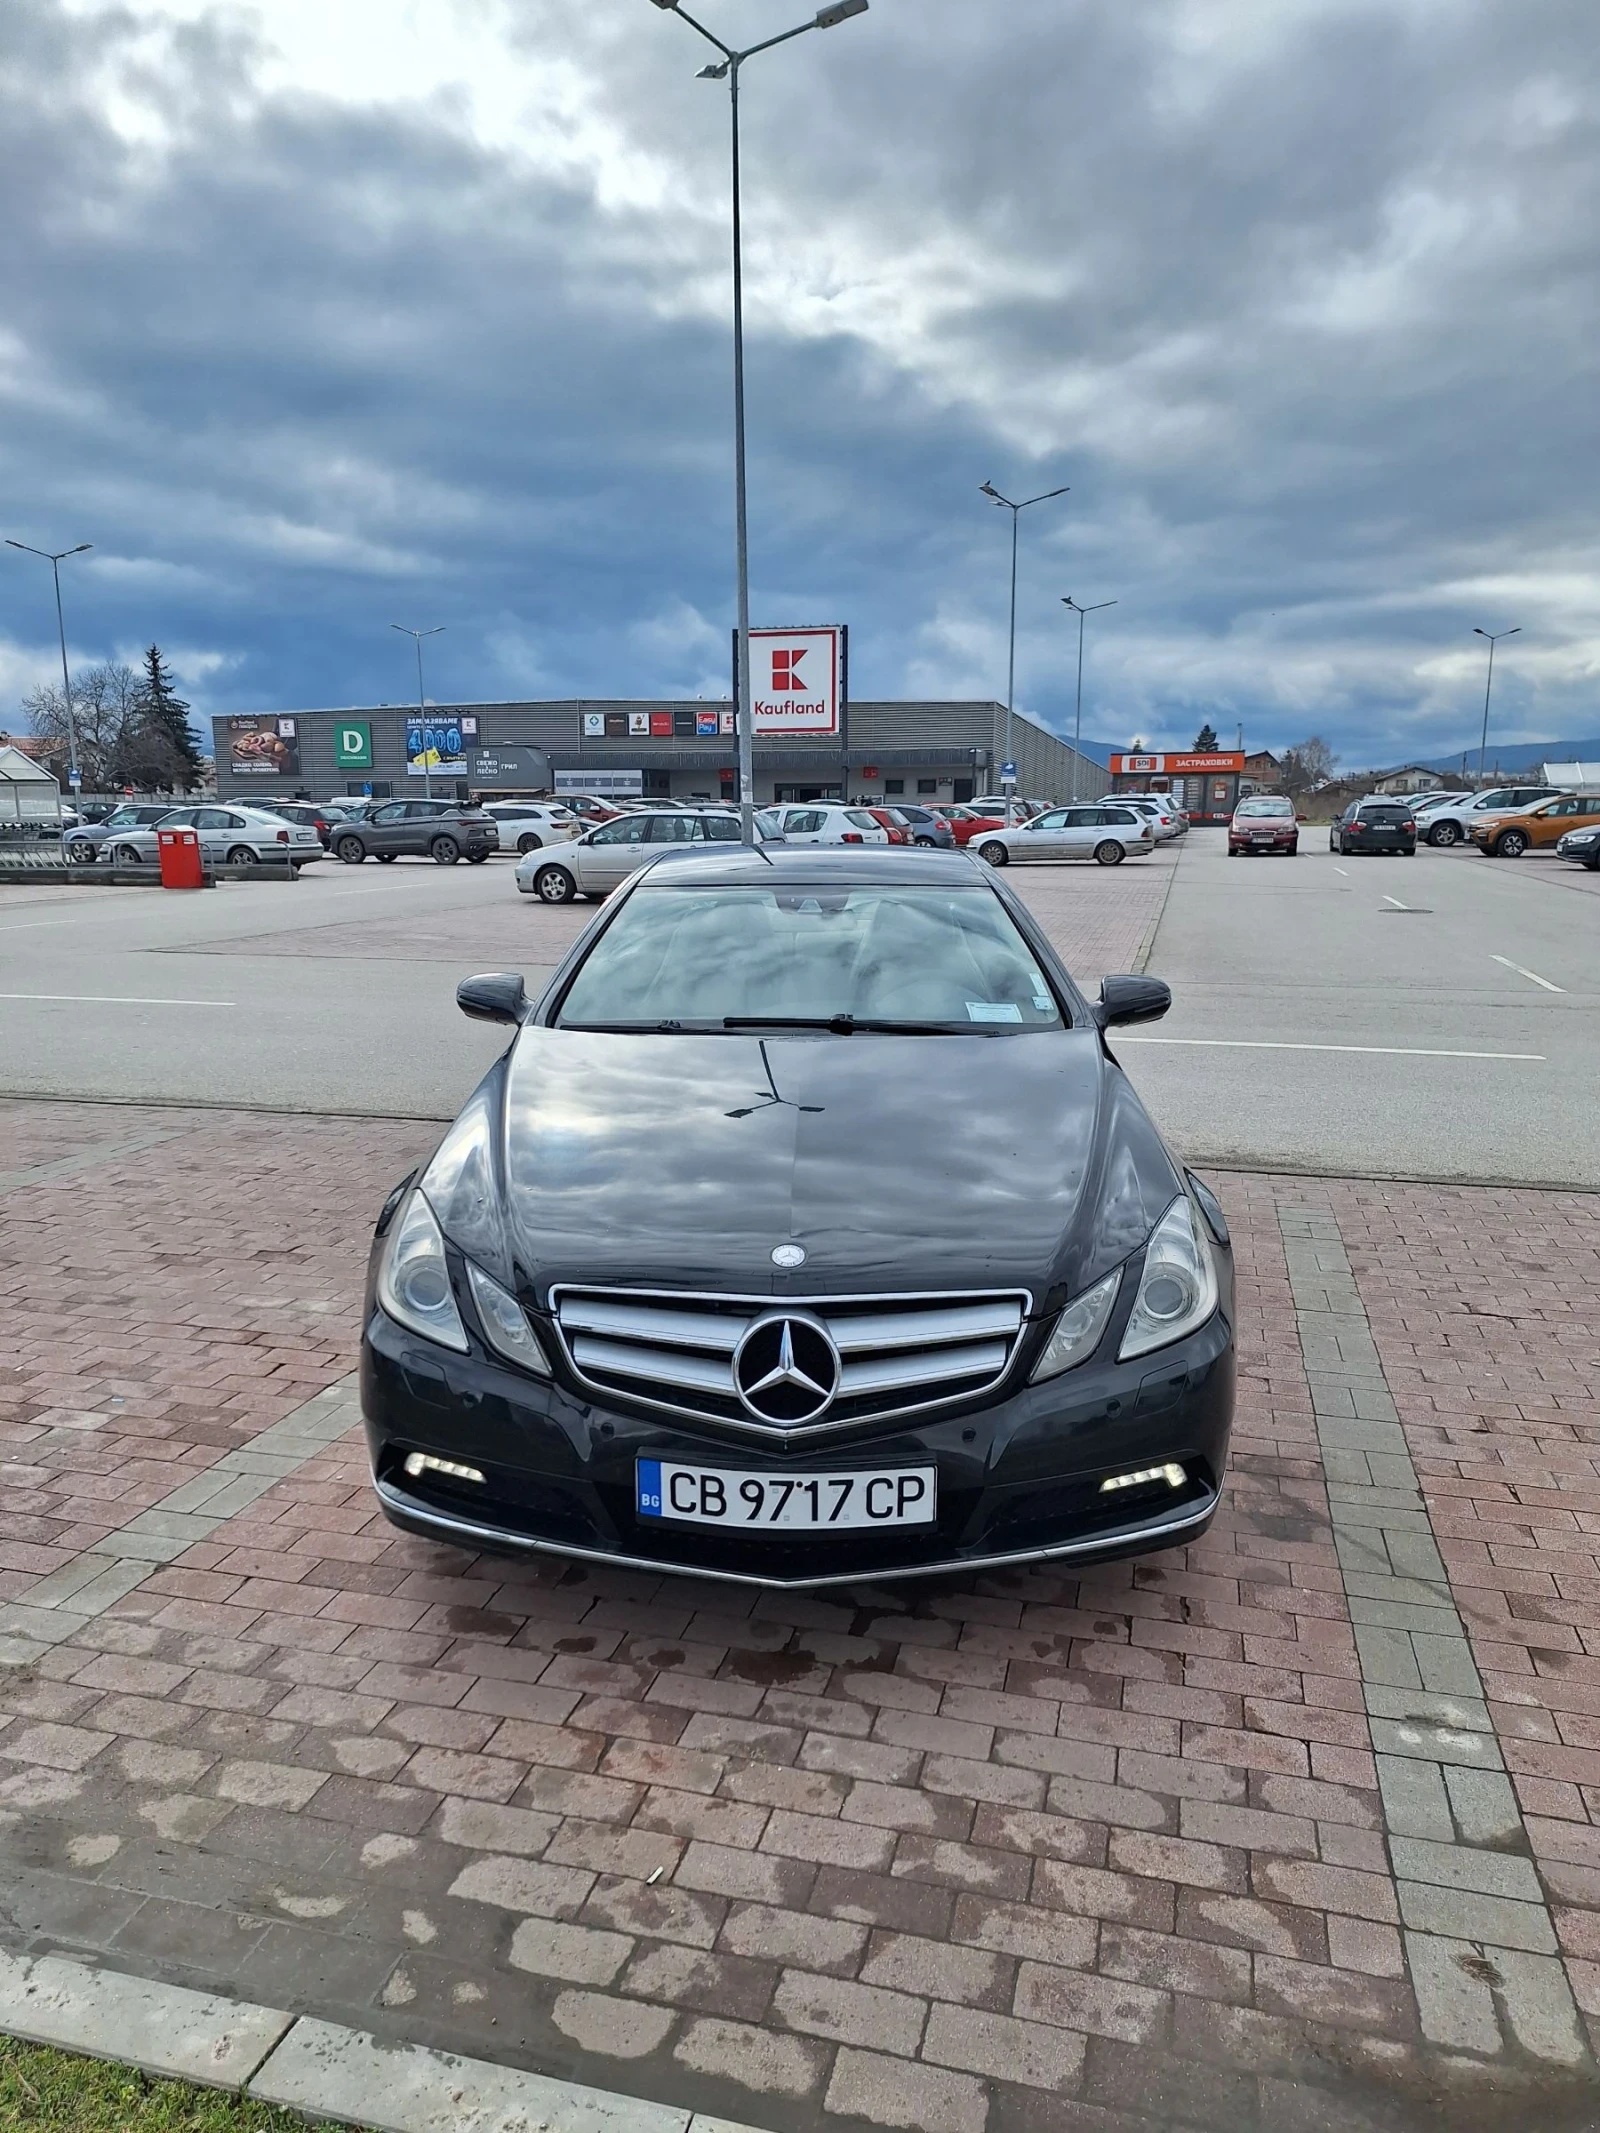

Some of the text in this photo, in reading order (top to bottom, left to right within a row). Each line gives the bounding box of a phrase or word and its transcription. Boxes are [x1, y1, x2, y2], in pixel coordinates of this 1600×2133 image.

[754, 699, 825, 715] Kaufland
[407, 717, 458, 725] ЗАМАЗЯВАМЕ
[699, 716, 716, 724] Easy
[699, 724, 712, 732] Pay
[408, 728, 462, 753] 4000
[1176, 758, 1233, 767] ЗАСТРАХОВКИ
[641, 1493, 660, 1508] BG
[669, 1472, 925, 1522] CB 9717 CP
